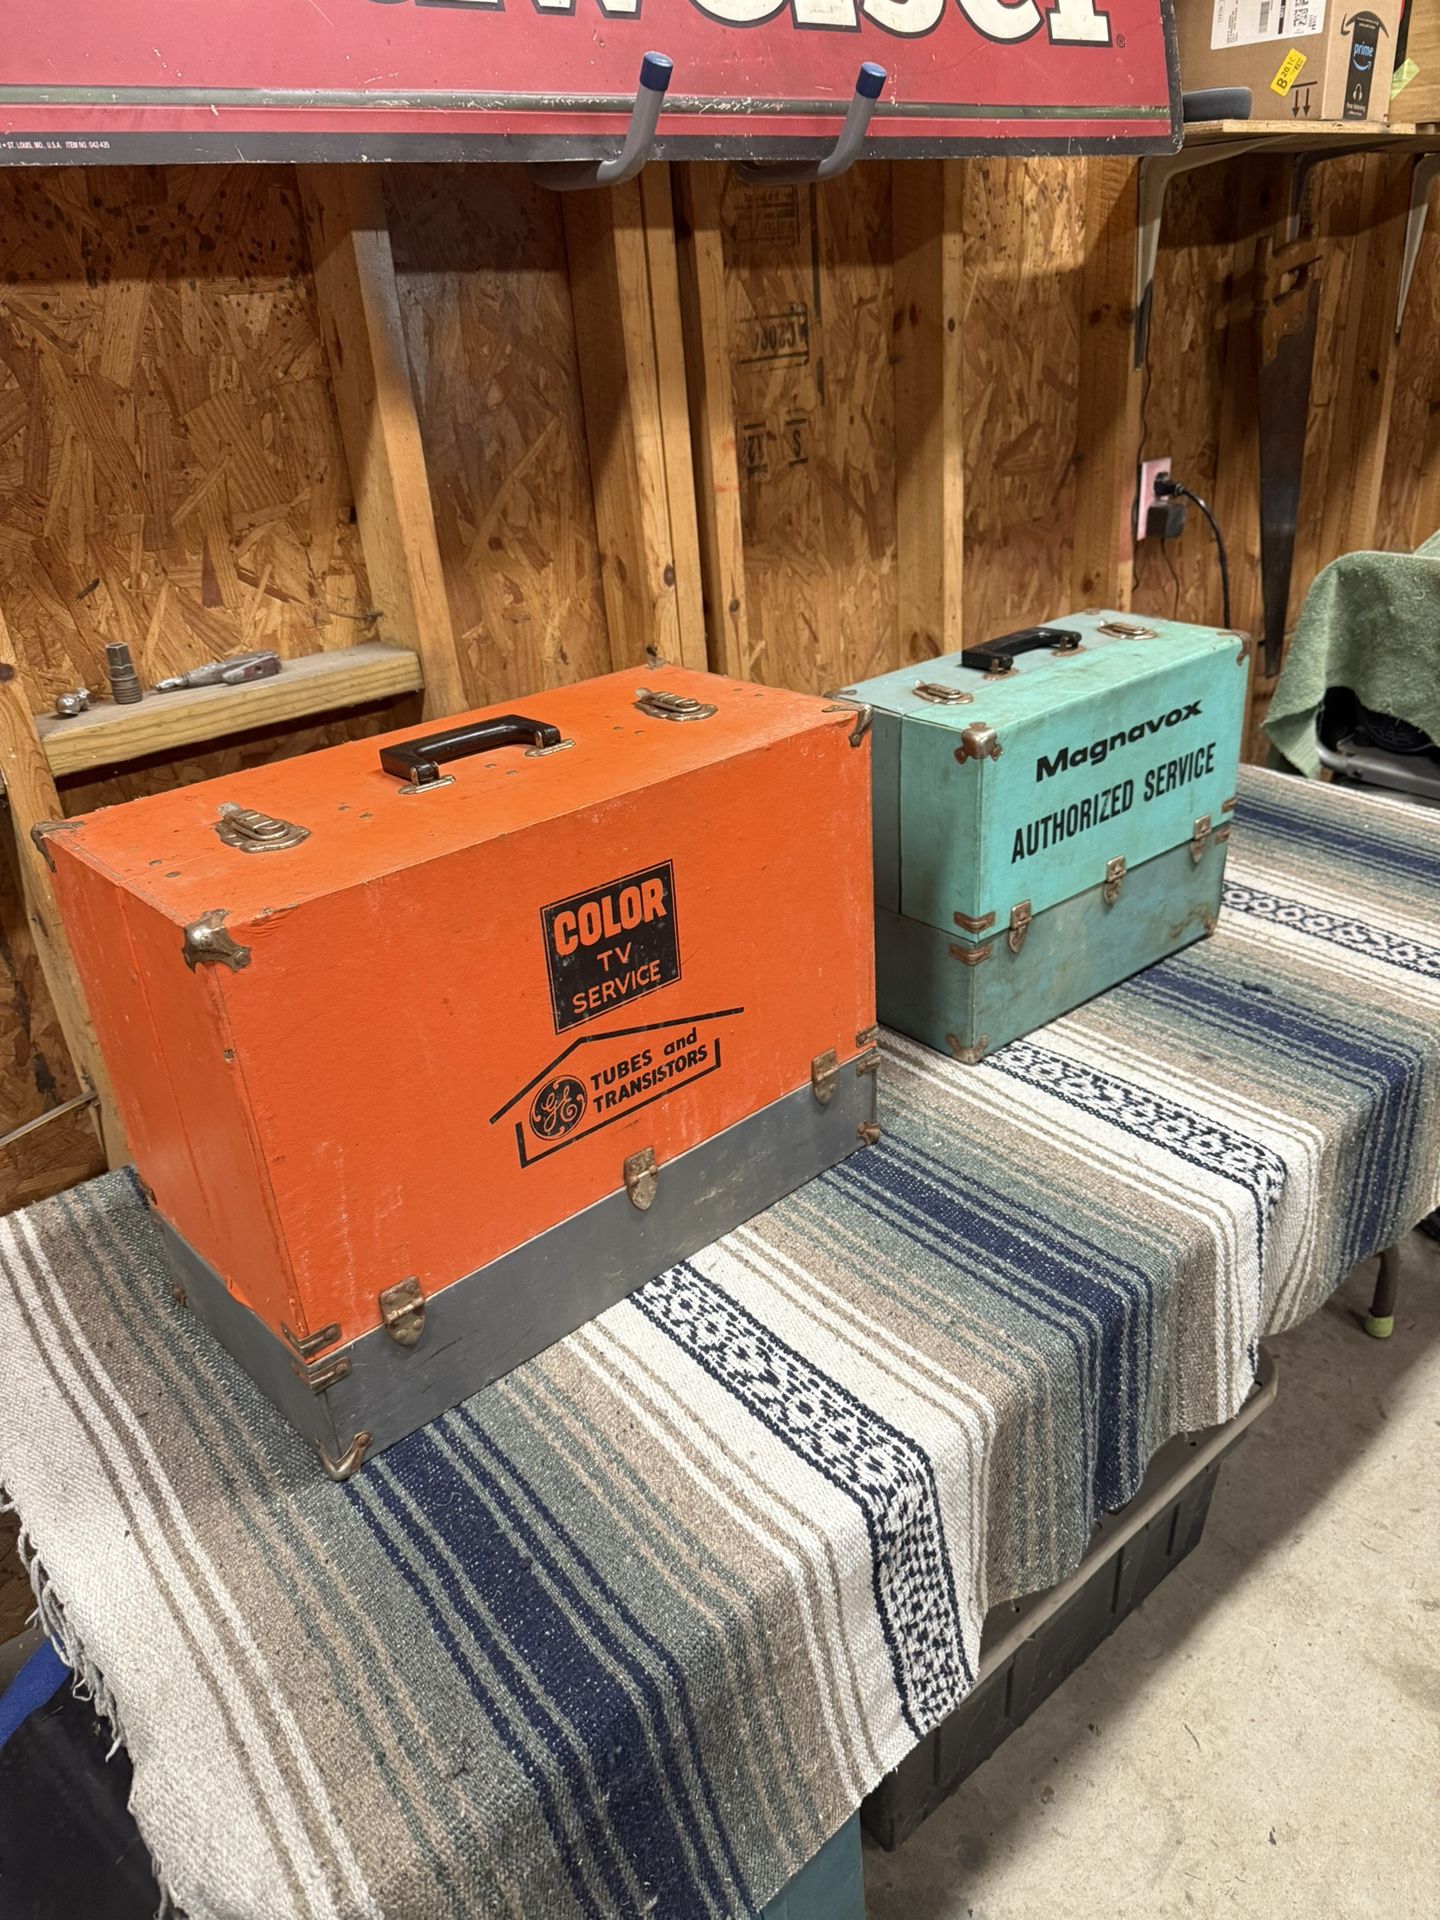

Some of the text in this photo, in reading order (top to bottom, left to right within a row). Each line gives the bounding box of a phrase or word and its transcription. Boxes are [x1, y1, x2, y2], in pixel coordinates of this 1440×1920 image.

[1353, 41, 1374, 58] prime
[1276, 78, 1288, 89] B
[1035, 699, 1203, 783] Magnavox
[1011, 742, 1217, 864] AUTHORIZED SERVICE
[552, 877, 667, 957] COLOR
[597, 941, 634, 972] TV
[571, 959, 662, 1014] SERVICE
[590, 1027, 698, 1090] TUBES and
[593, 1044, 708, 1114] TRANSISTORS
[538, 1082, 580, 1133] GE
